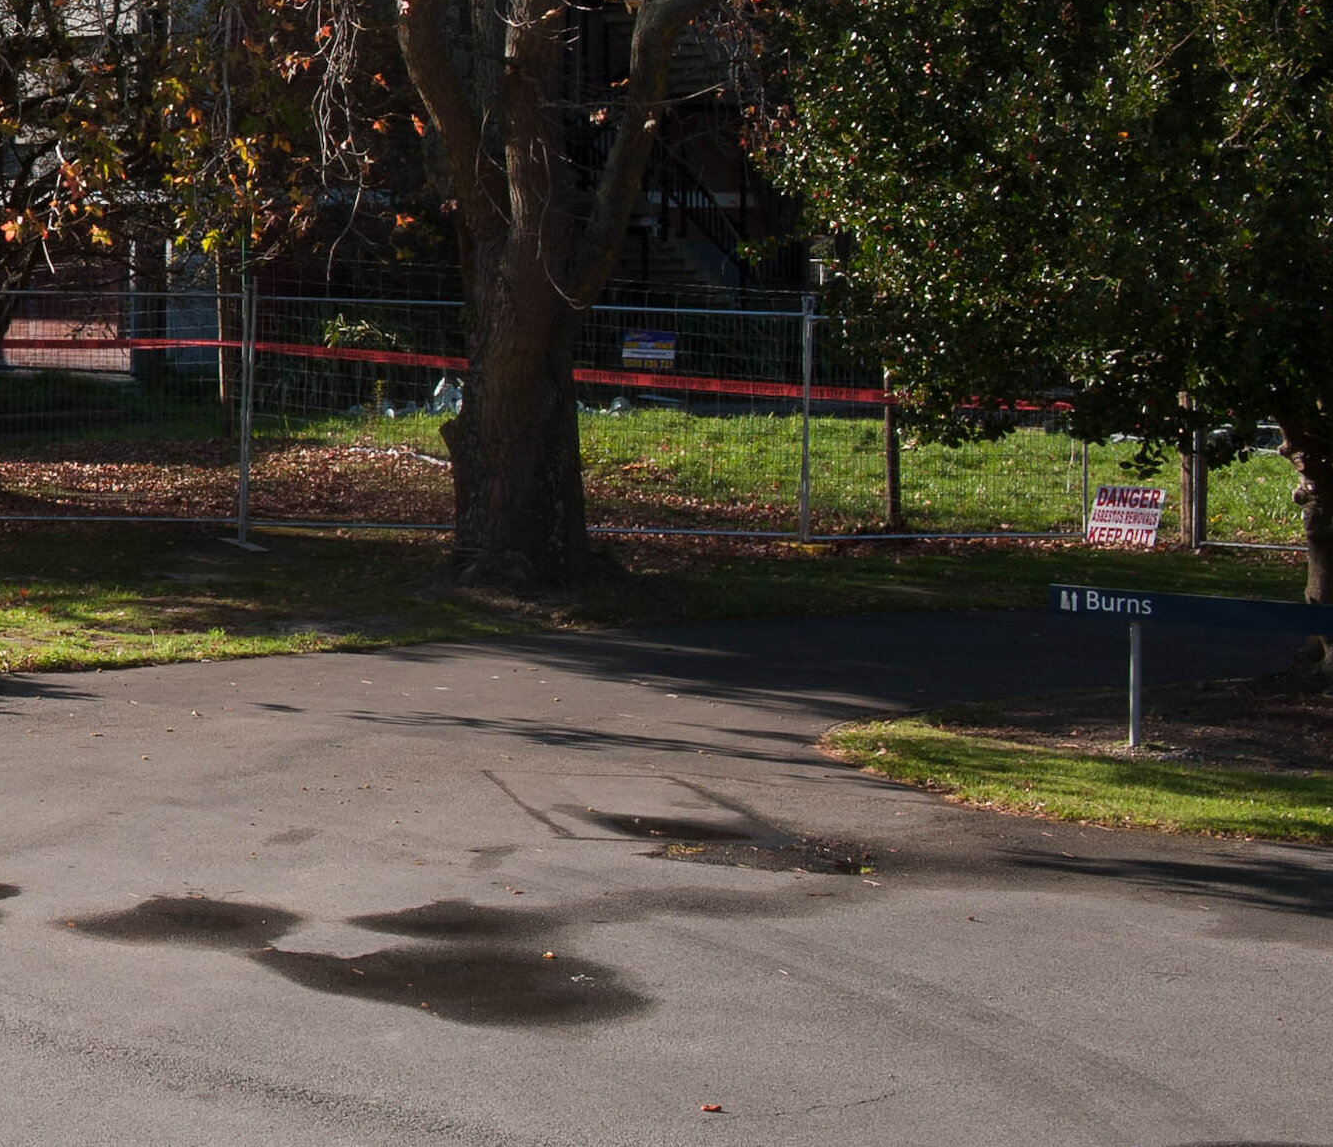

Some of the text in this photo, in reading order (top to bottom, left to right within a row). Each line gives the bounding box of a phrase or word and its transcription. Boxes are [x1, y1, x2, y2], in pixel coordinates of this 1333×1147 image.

[1097, 488, 1162, 508] DANGER
[1092, 509, 1159, 525] ASBESTOS REMOVALS
[1087, 527, 1154, 545] KEEP OUT
[1086, 590, 1153, 615] Burns
